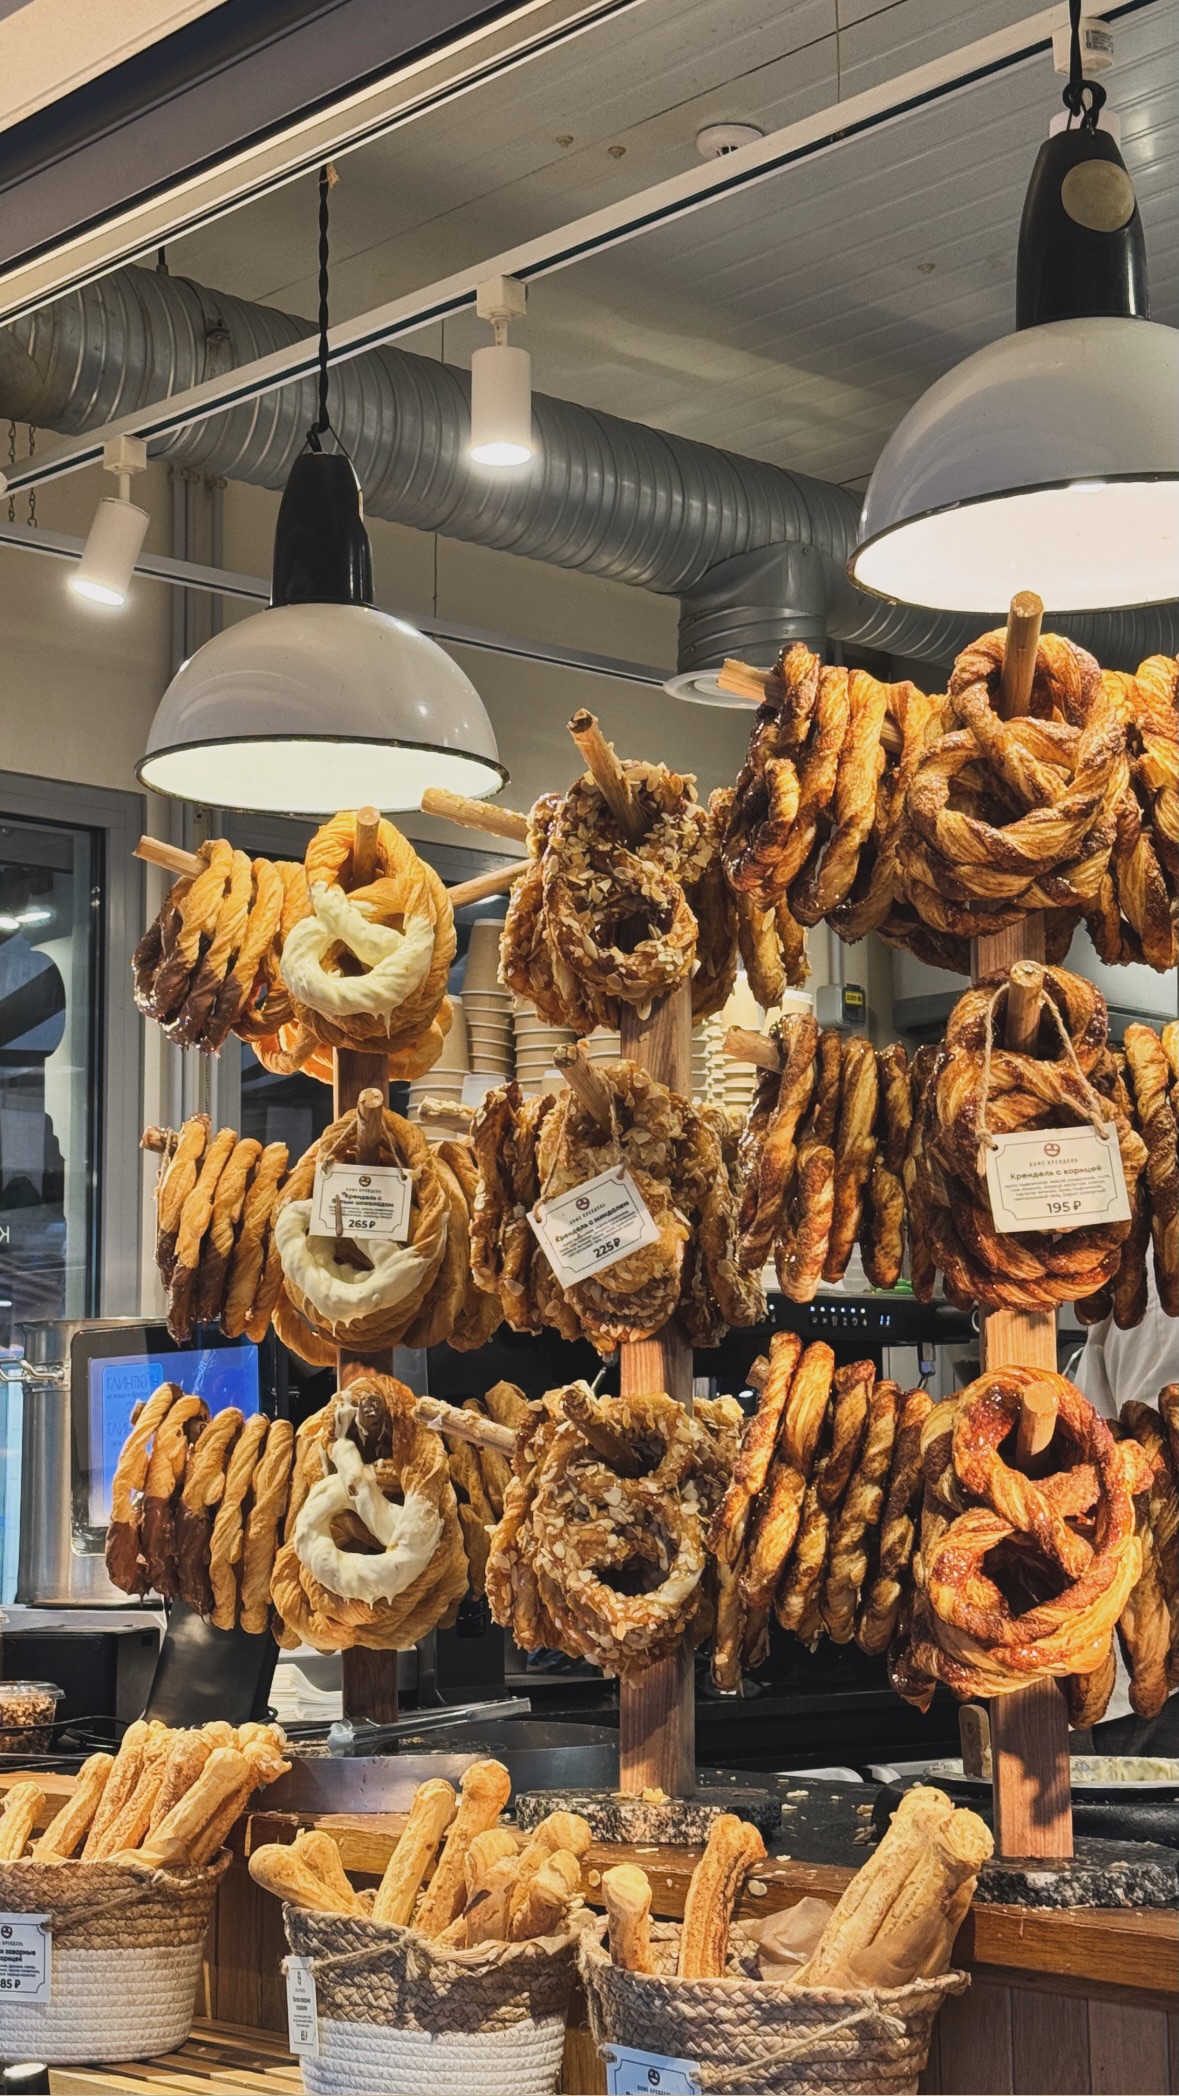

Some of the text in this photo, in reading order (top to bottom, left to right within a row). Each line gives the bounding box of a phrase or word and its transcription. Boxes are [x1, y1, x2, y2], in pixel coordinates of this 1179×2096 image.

[1010, 1170, 1054, 1182] Крендель
[1063, 1164, 1103, 1176] корицей
[355, 1200, 394, 1208] шоколадом
[555, 1222, 588, 1242] Крендель
[588, 1218, 594, 1226] с
